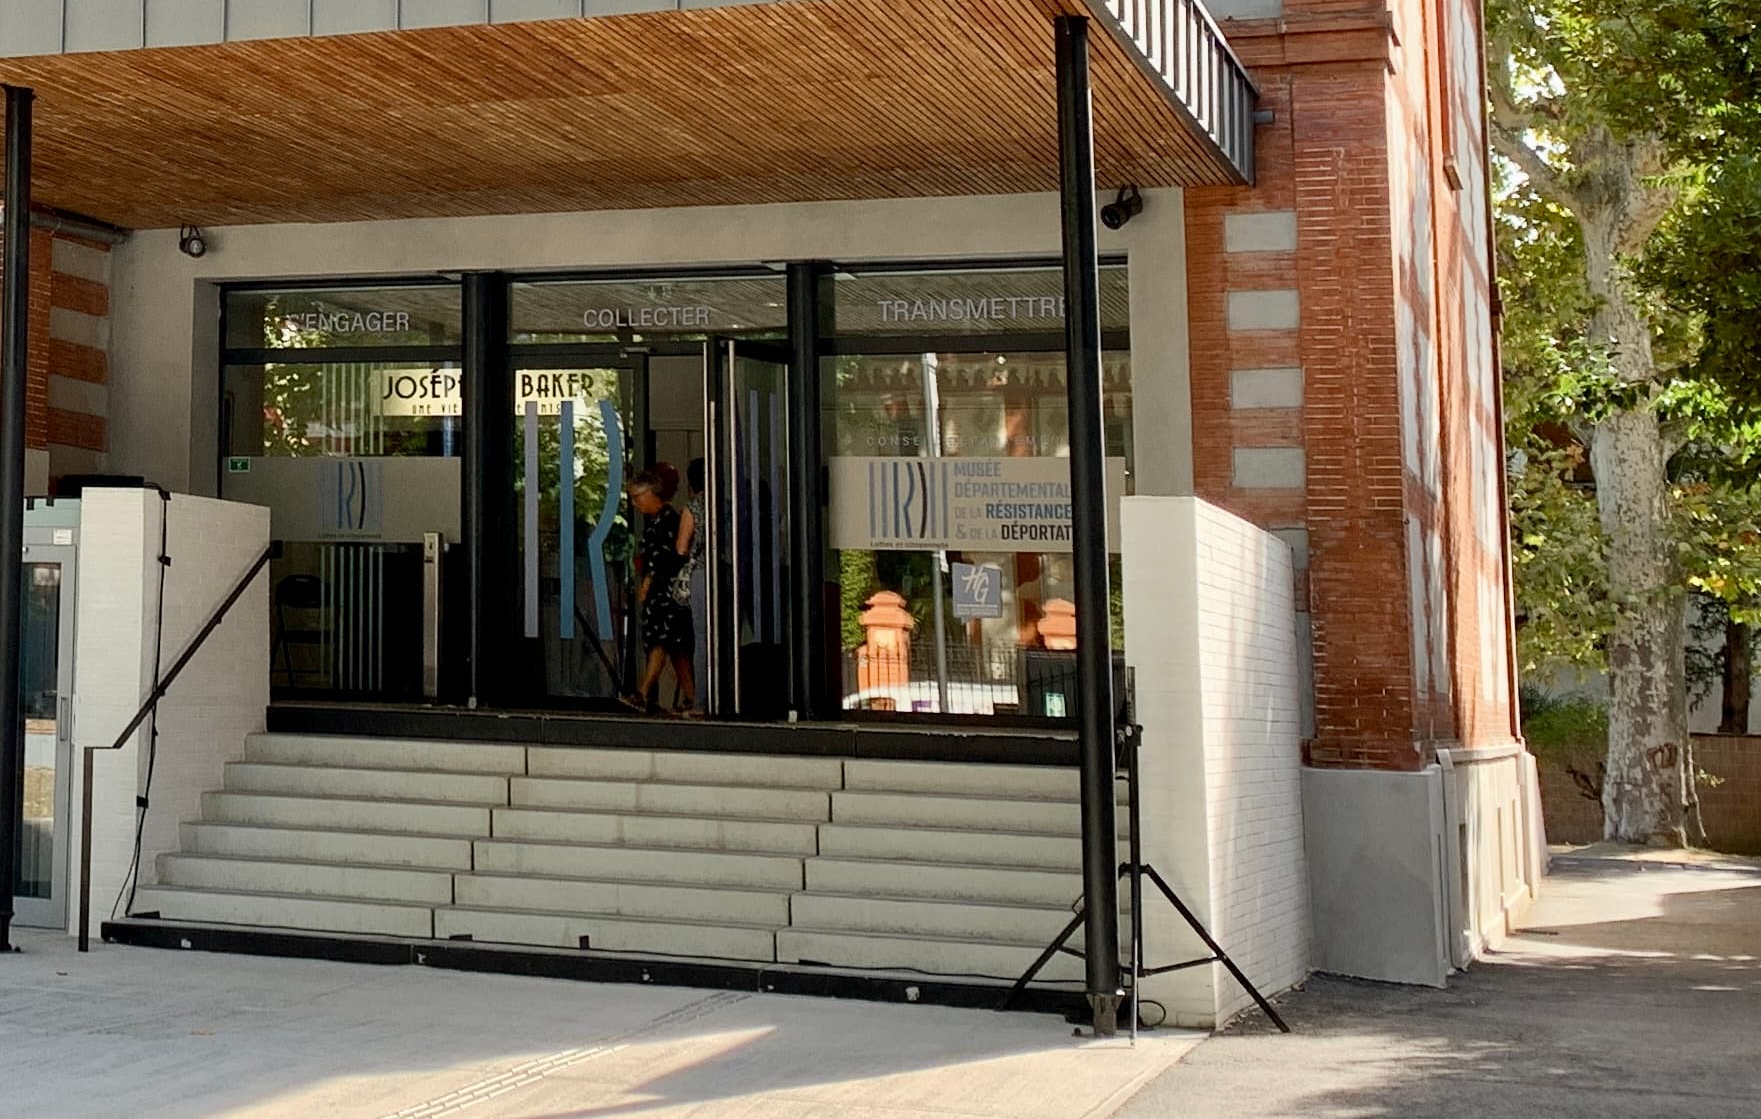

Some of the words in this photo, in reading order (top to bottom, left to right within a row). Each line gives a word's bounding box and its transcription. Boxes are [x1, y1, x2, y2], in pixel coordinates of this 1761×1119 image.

[290, 311, 410, 332] S'ENGAGER
[583, 306, 710, 328] COLLECTER
[383, 368, 462, 400] JOSÉP
[521, 373, 594, 398] BAKER
[953, 458, 1002, 478] MUSÉE
[954, 479, 1071, 499] DÉPARTEMENTAL
[985, 500, 1072, 520] RÉSISTANCE
[955, 523, 967, 540] &
[1001, 521, 1072, 541] DÉPORTAT
